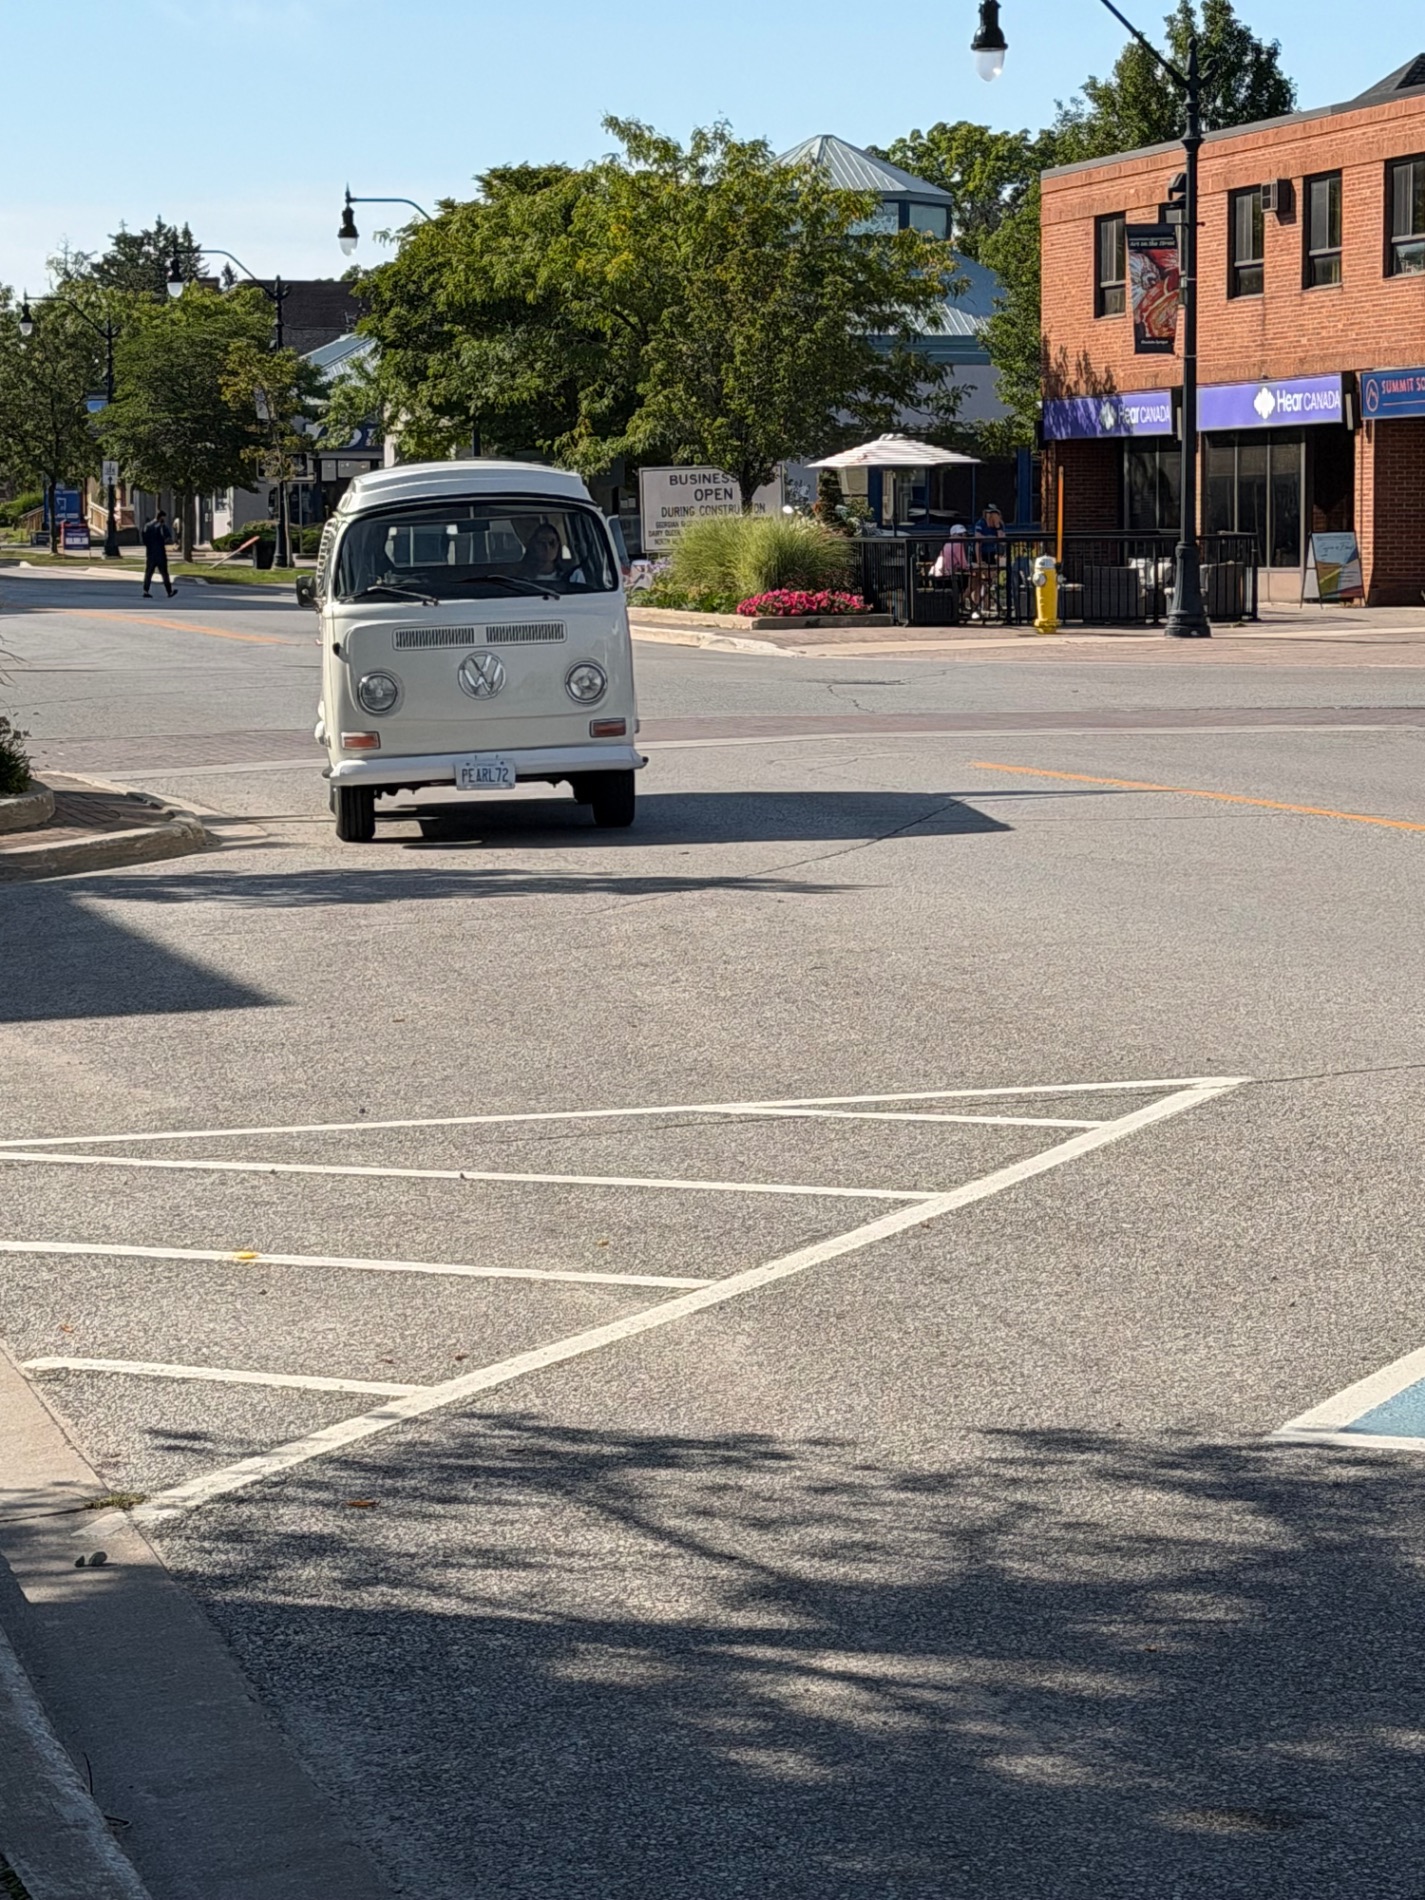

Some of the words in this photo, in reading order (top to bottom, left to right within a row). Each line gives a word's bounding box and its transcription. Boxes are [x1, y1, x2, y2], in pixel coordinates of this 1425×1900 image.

[1381, 377, 1414, 395] SUMMIT
[694, 488, 733, 501] OPEN
[661, 506, 695, 518] DURING
[461, 767, 509, 784] PEARL72
